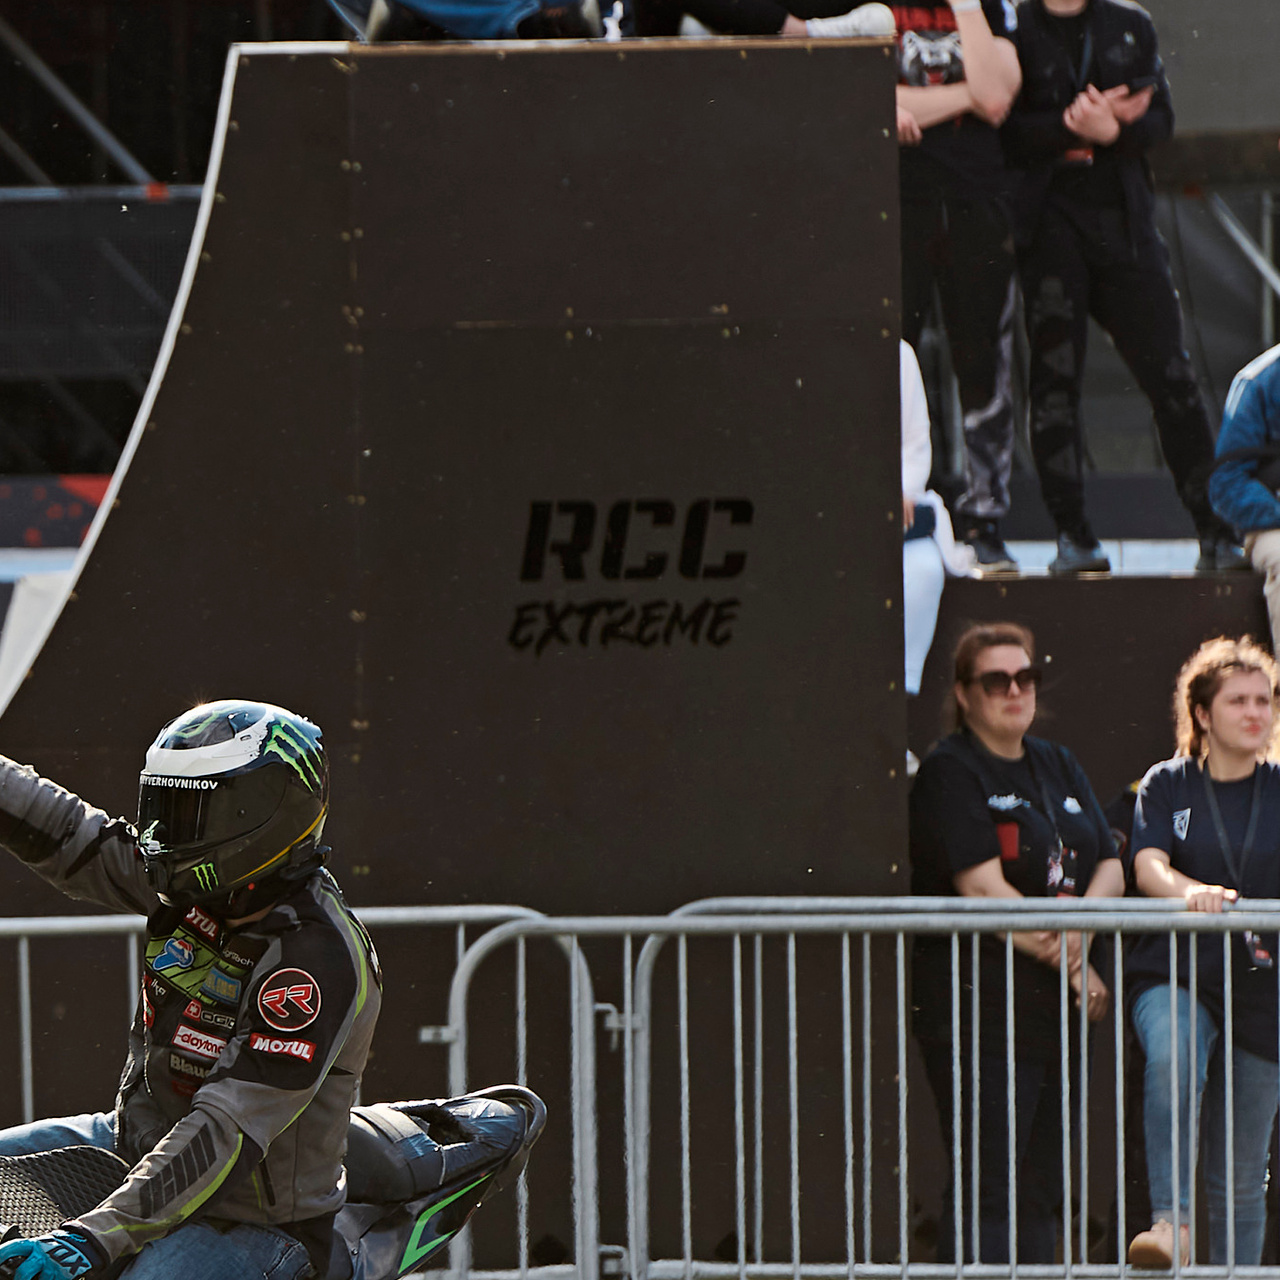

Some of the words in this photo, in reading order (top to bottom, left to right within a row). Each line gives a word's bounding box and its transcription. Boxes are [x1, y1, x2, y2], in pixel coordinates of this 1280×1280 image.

[520, 498, 755, 582] RCC
[507, 596, 742, 660] EXTREME
[253, 1037, 311, 1059] MOTUL
